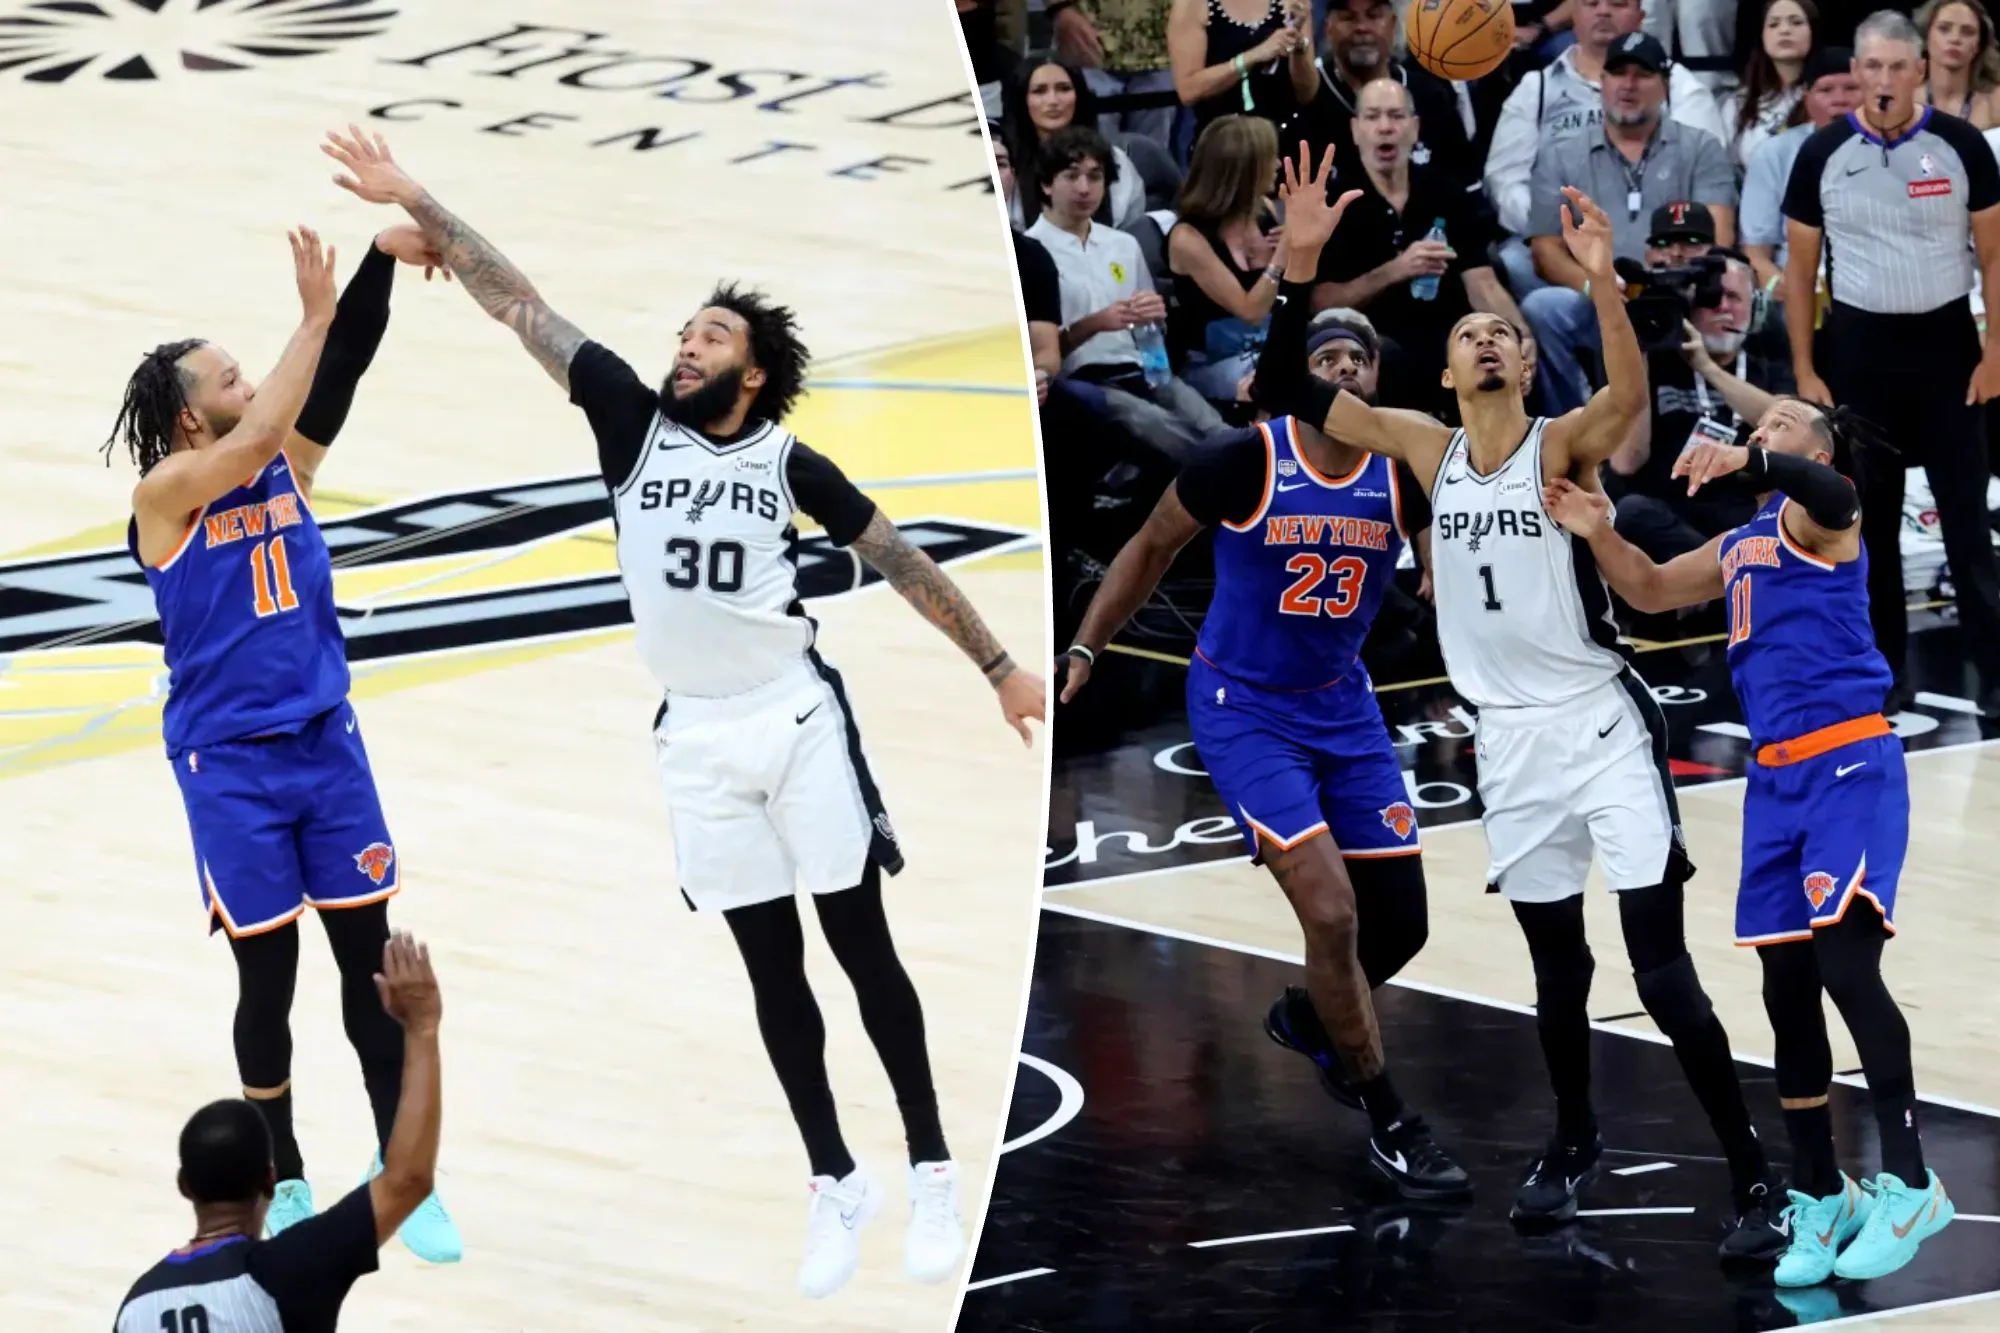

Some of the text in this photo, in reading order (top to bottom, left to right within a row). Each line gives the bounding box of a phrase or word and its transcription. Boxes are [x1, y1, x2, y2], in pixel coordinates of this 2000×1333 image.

[377, 22, 889, 114] Frost
[1669, 203, 1690, 225] T
[204, 502, 268, 550] NEW
[640, 478, 779, 525] SPURS
[1264, 514, 1392, 551] NEW YORK
[1438, 509, 1542, 553] SPURS
[250, 534, 300, 619] 11
[662, 535, 746, 594] 30
[1278, 551, 1369, 618] 23
[1479, 562, 1505, 614] 1
[1727, 571, 1752, 650] 11
